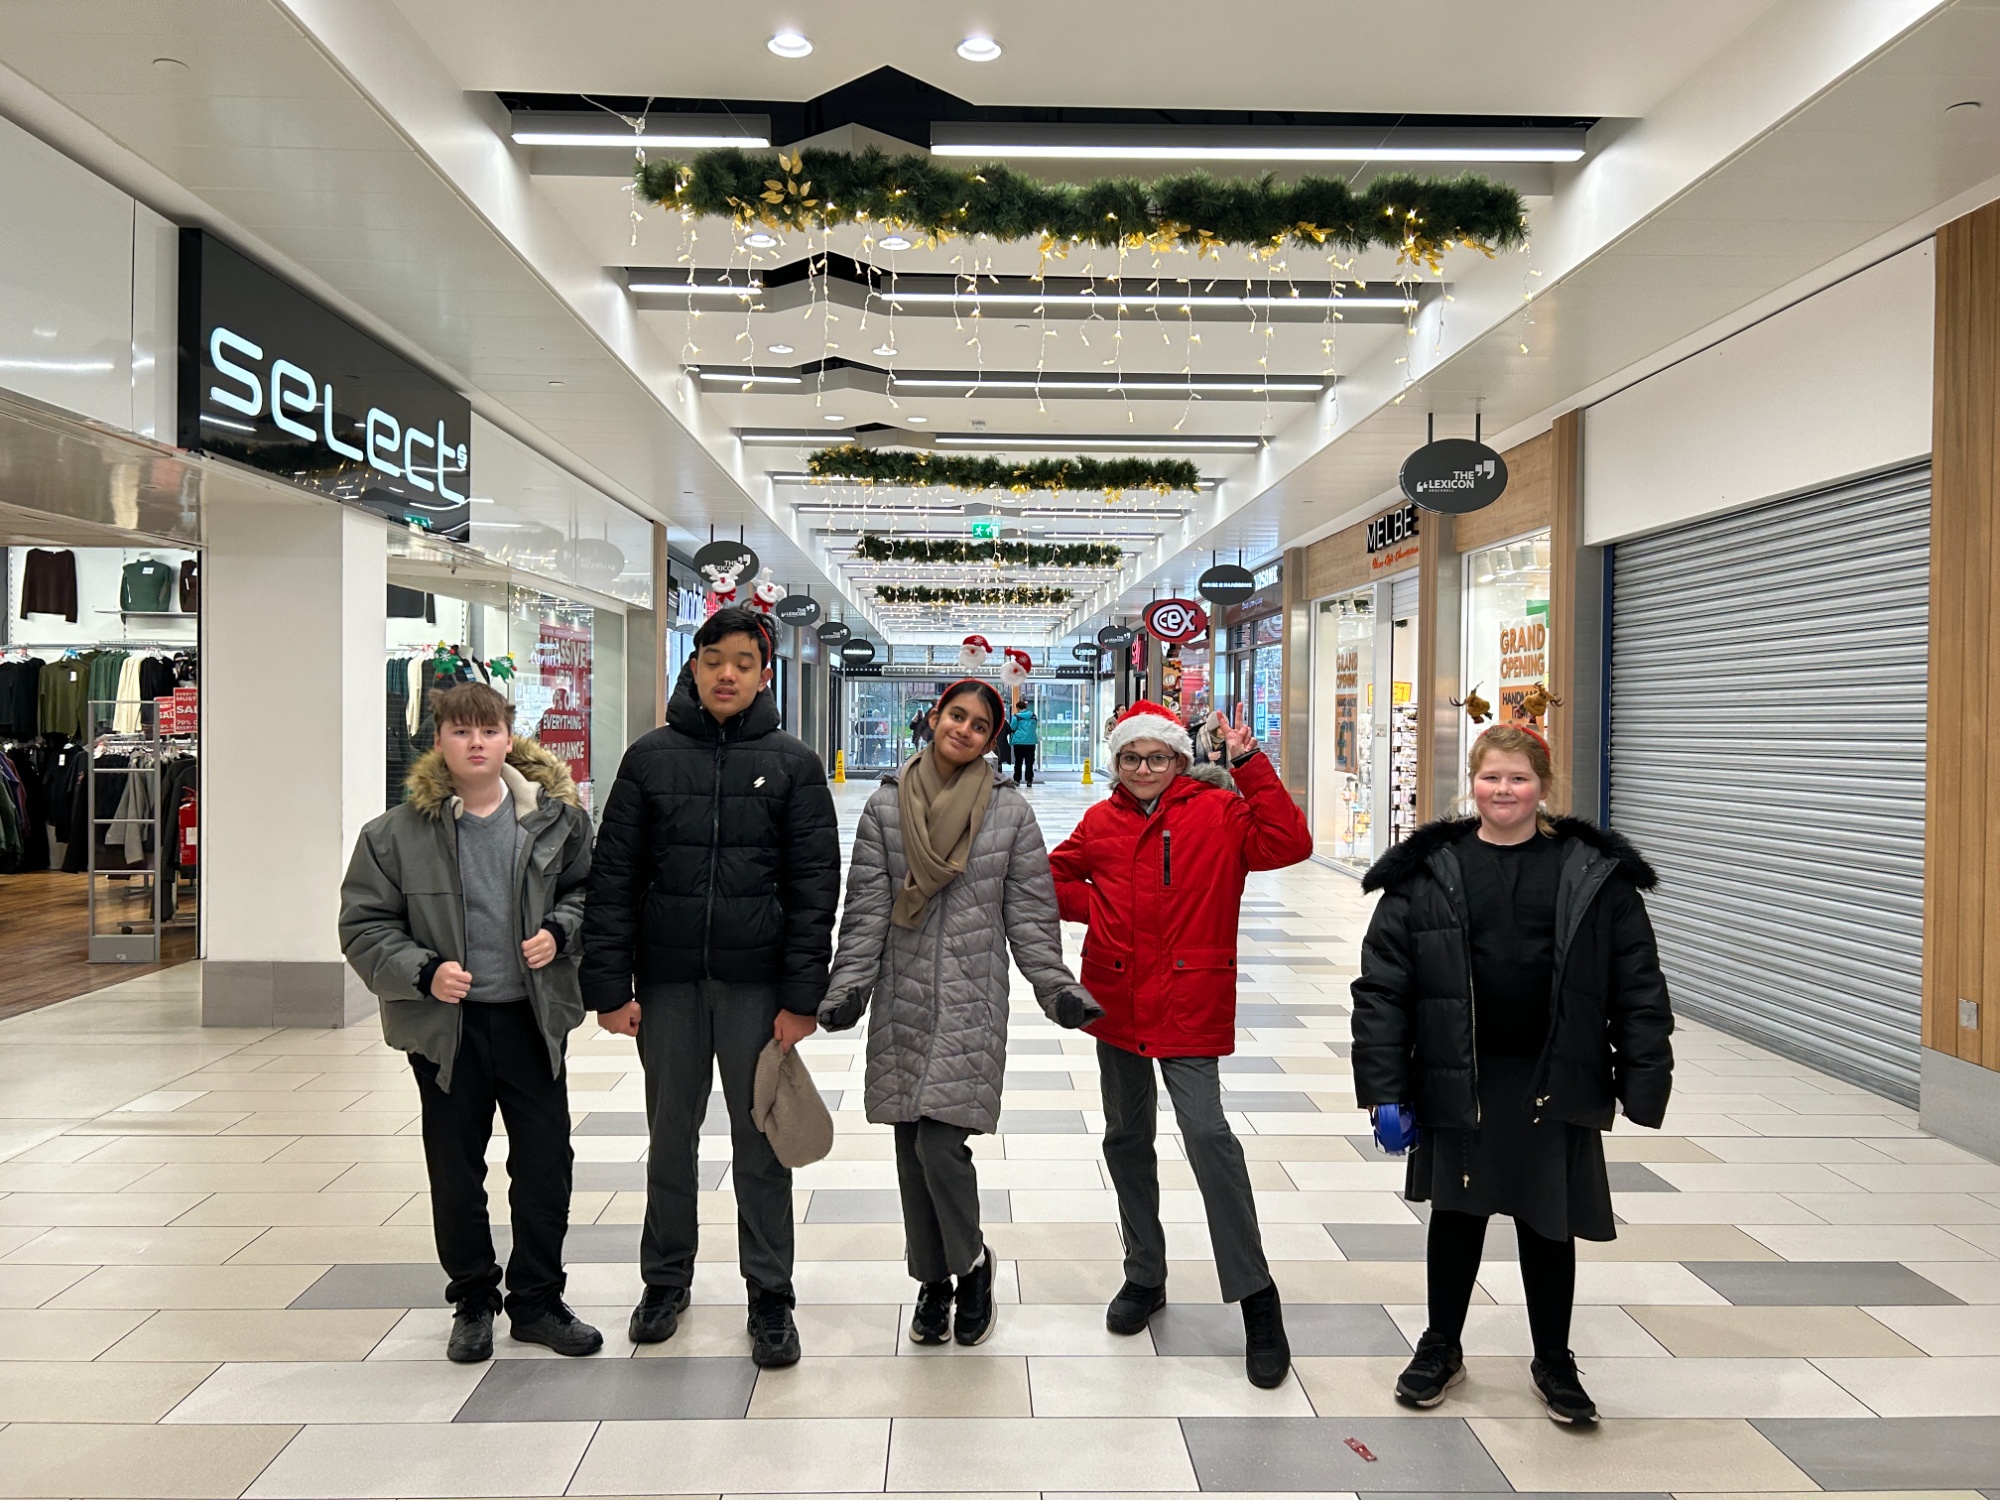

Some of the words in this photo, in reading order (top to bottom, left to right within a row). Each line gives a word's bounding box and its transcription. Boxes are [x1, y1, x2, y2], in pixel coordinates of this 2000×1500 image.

[1428, 480, 1475, 489] LEXICON
[1453, 471, 1475, 480] THE
[1499, 623, 1546, 656] GRAND
[1335, 652, 1359, 673] GRAND
[1499, 653, 1545, 680] OPENING
[542, 714, 582, 731] EVERYTHING
